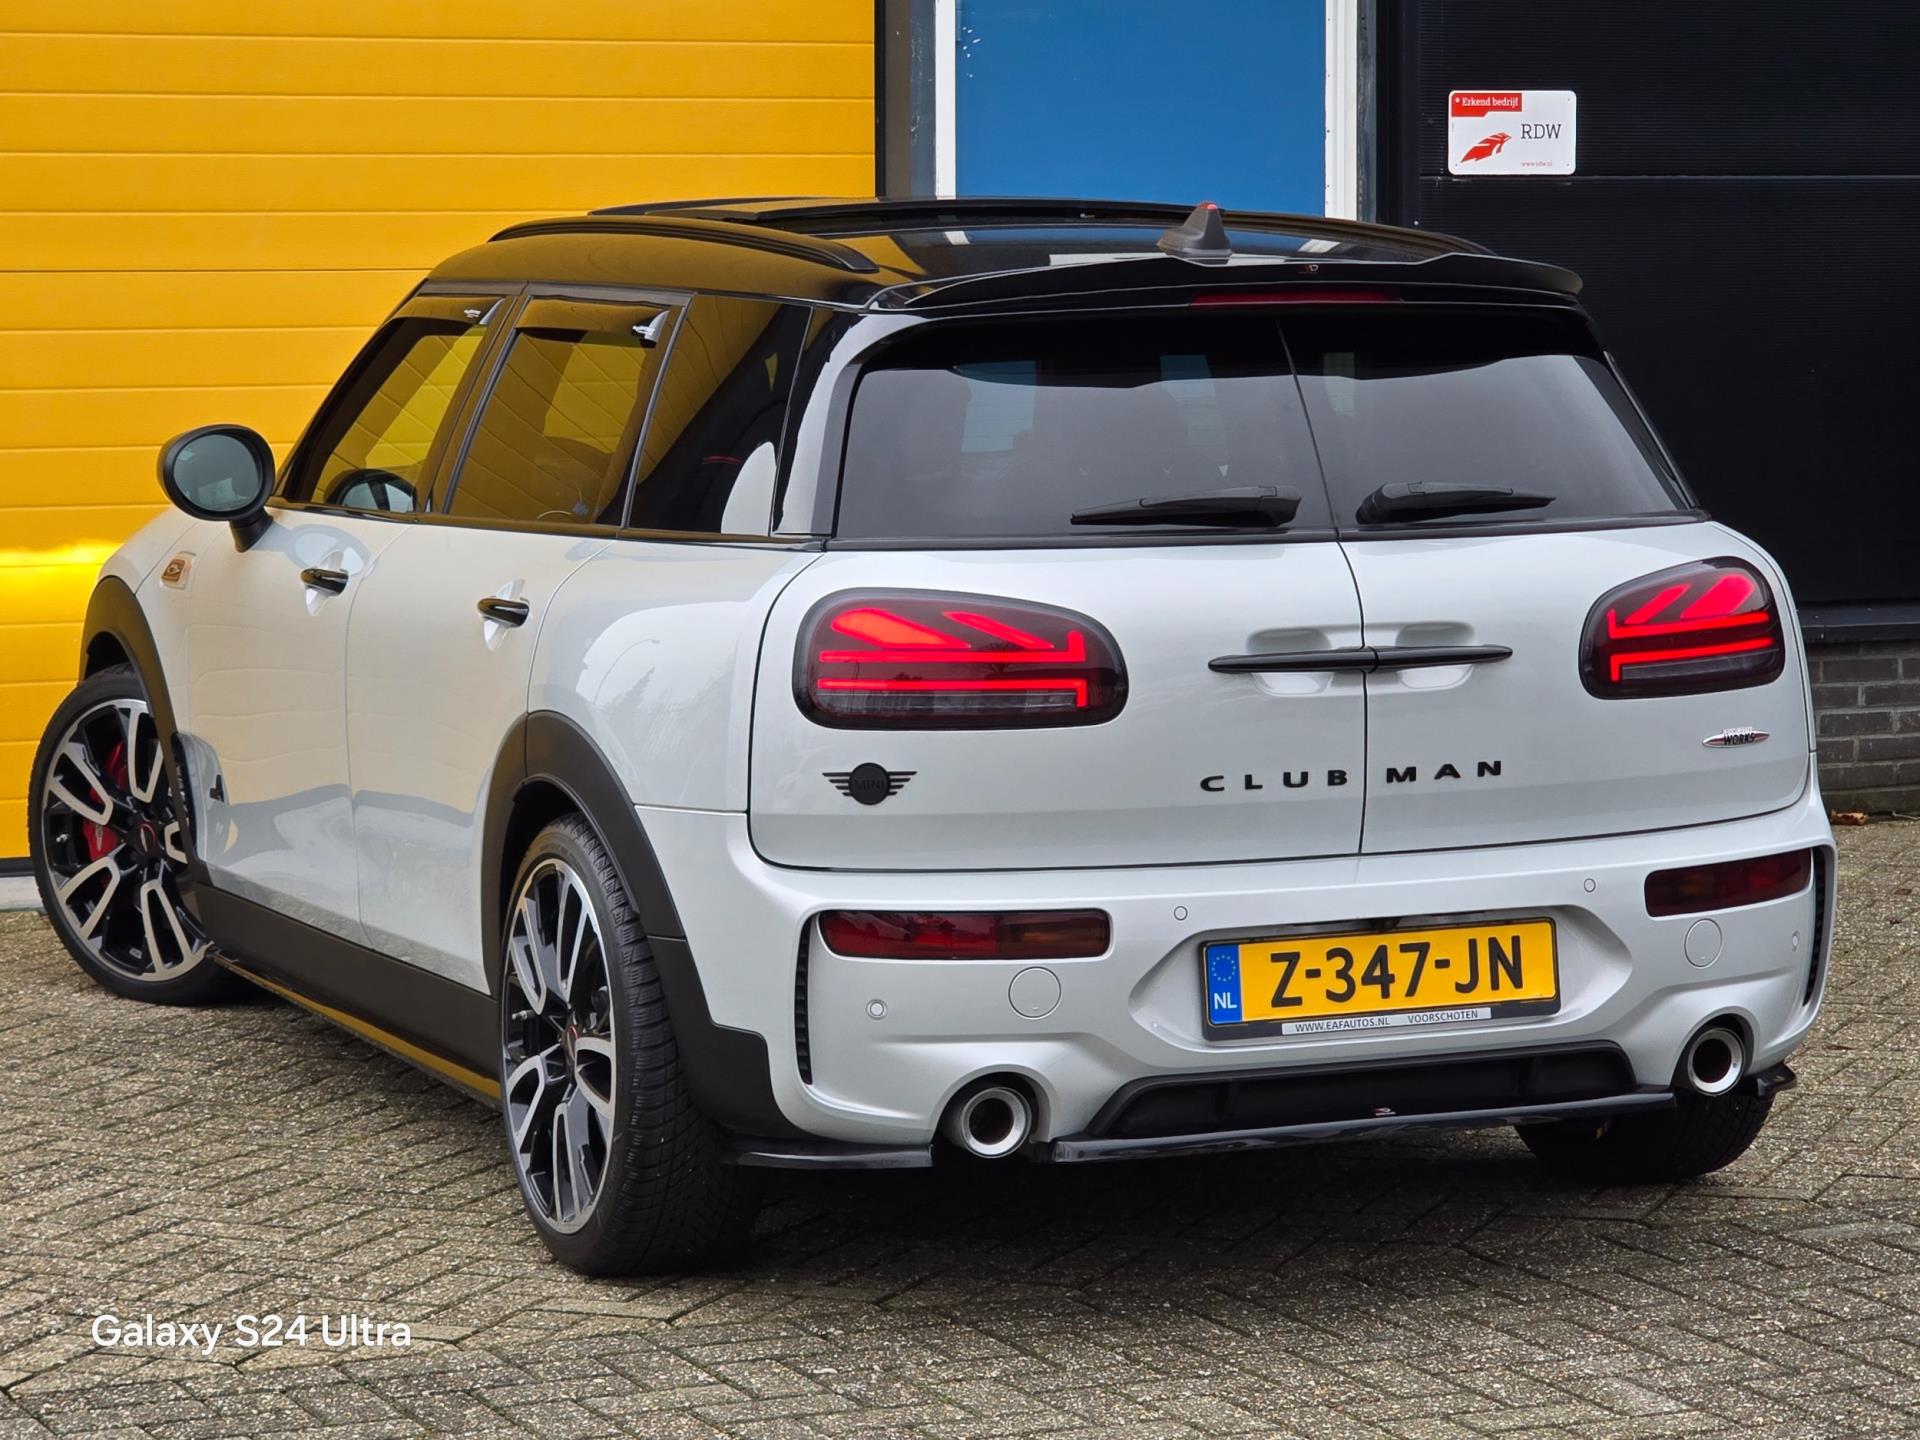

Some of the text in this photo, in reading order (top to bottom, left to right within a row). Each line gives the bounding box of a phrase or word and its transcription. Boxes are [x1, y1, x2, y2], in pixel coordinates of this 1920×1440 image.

[1462, 97, 1491, 107] Erkend
[1521, 124, 1562, 140] RDW
[1723, 732, 1756, 746] WORKS
[1200, 760, 1502, 792] CLUB MAN
[1270, 934, 1524, 1009] Z-347-JN
[1213, 992, 1238, 1010] NL
[1294, 1009, 1479, 1034] WWW.EAFAUTOS.NL VOORSCHOTEN
